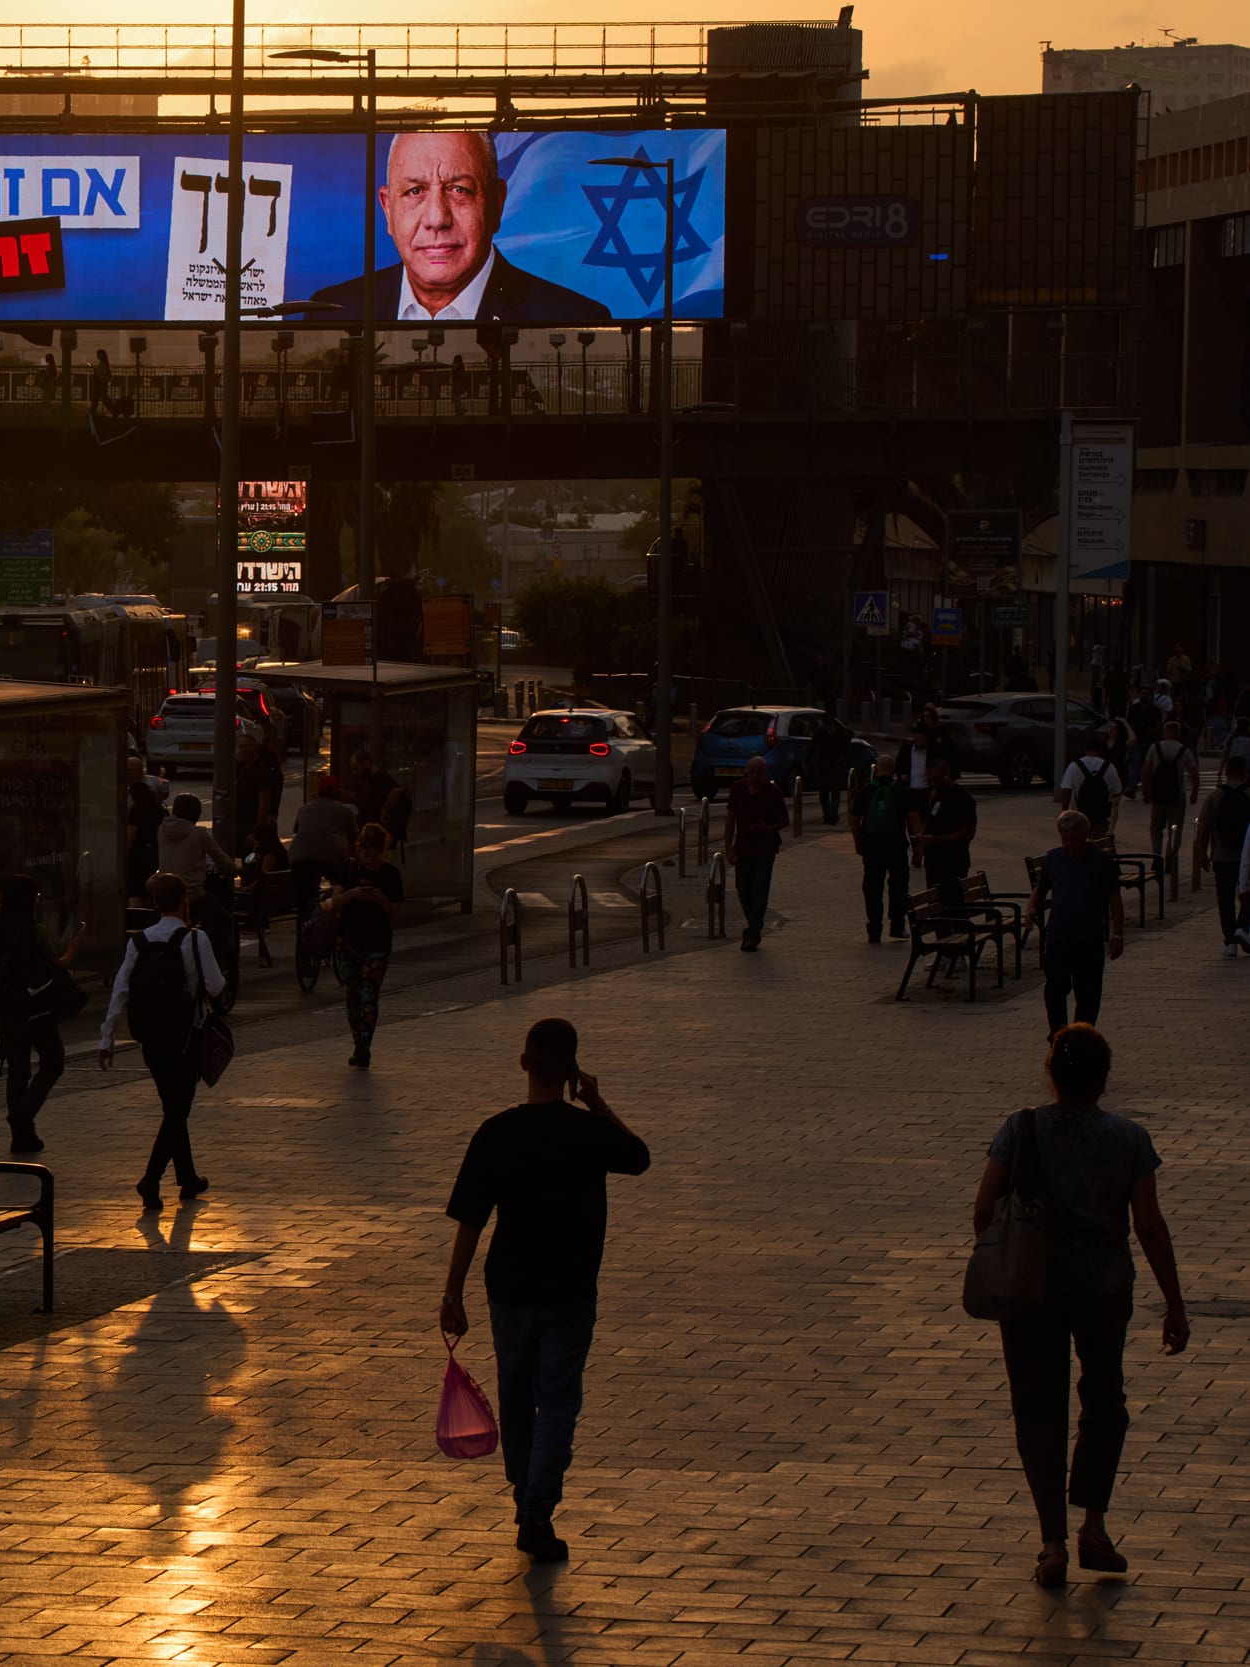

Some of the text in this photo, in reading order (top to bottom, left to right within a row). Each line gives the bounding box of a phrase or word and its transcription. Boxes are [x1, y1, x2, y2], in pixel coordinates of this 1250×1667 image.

[41, 168, 127, 216] אם
[186, 274, 226, 289] הממשלה
[182, 288, 212, 301] ישראל
[254, 582, 278, 592] 21:15
[280, 582, 299, 592] מחר
